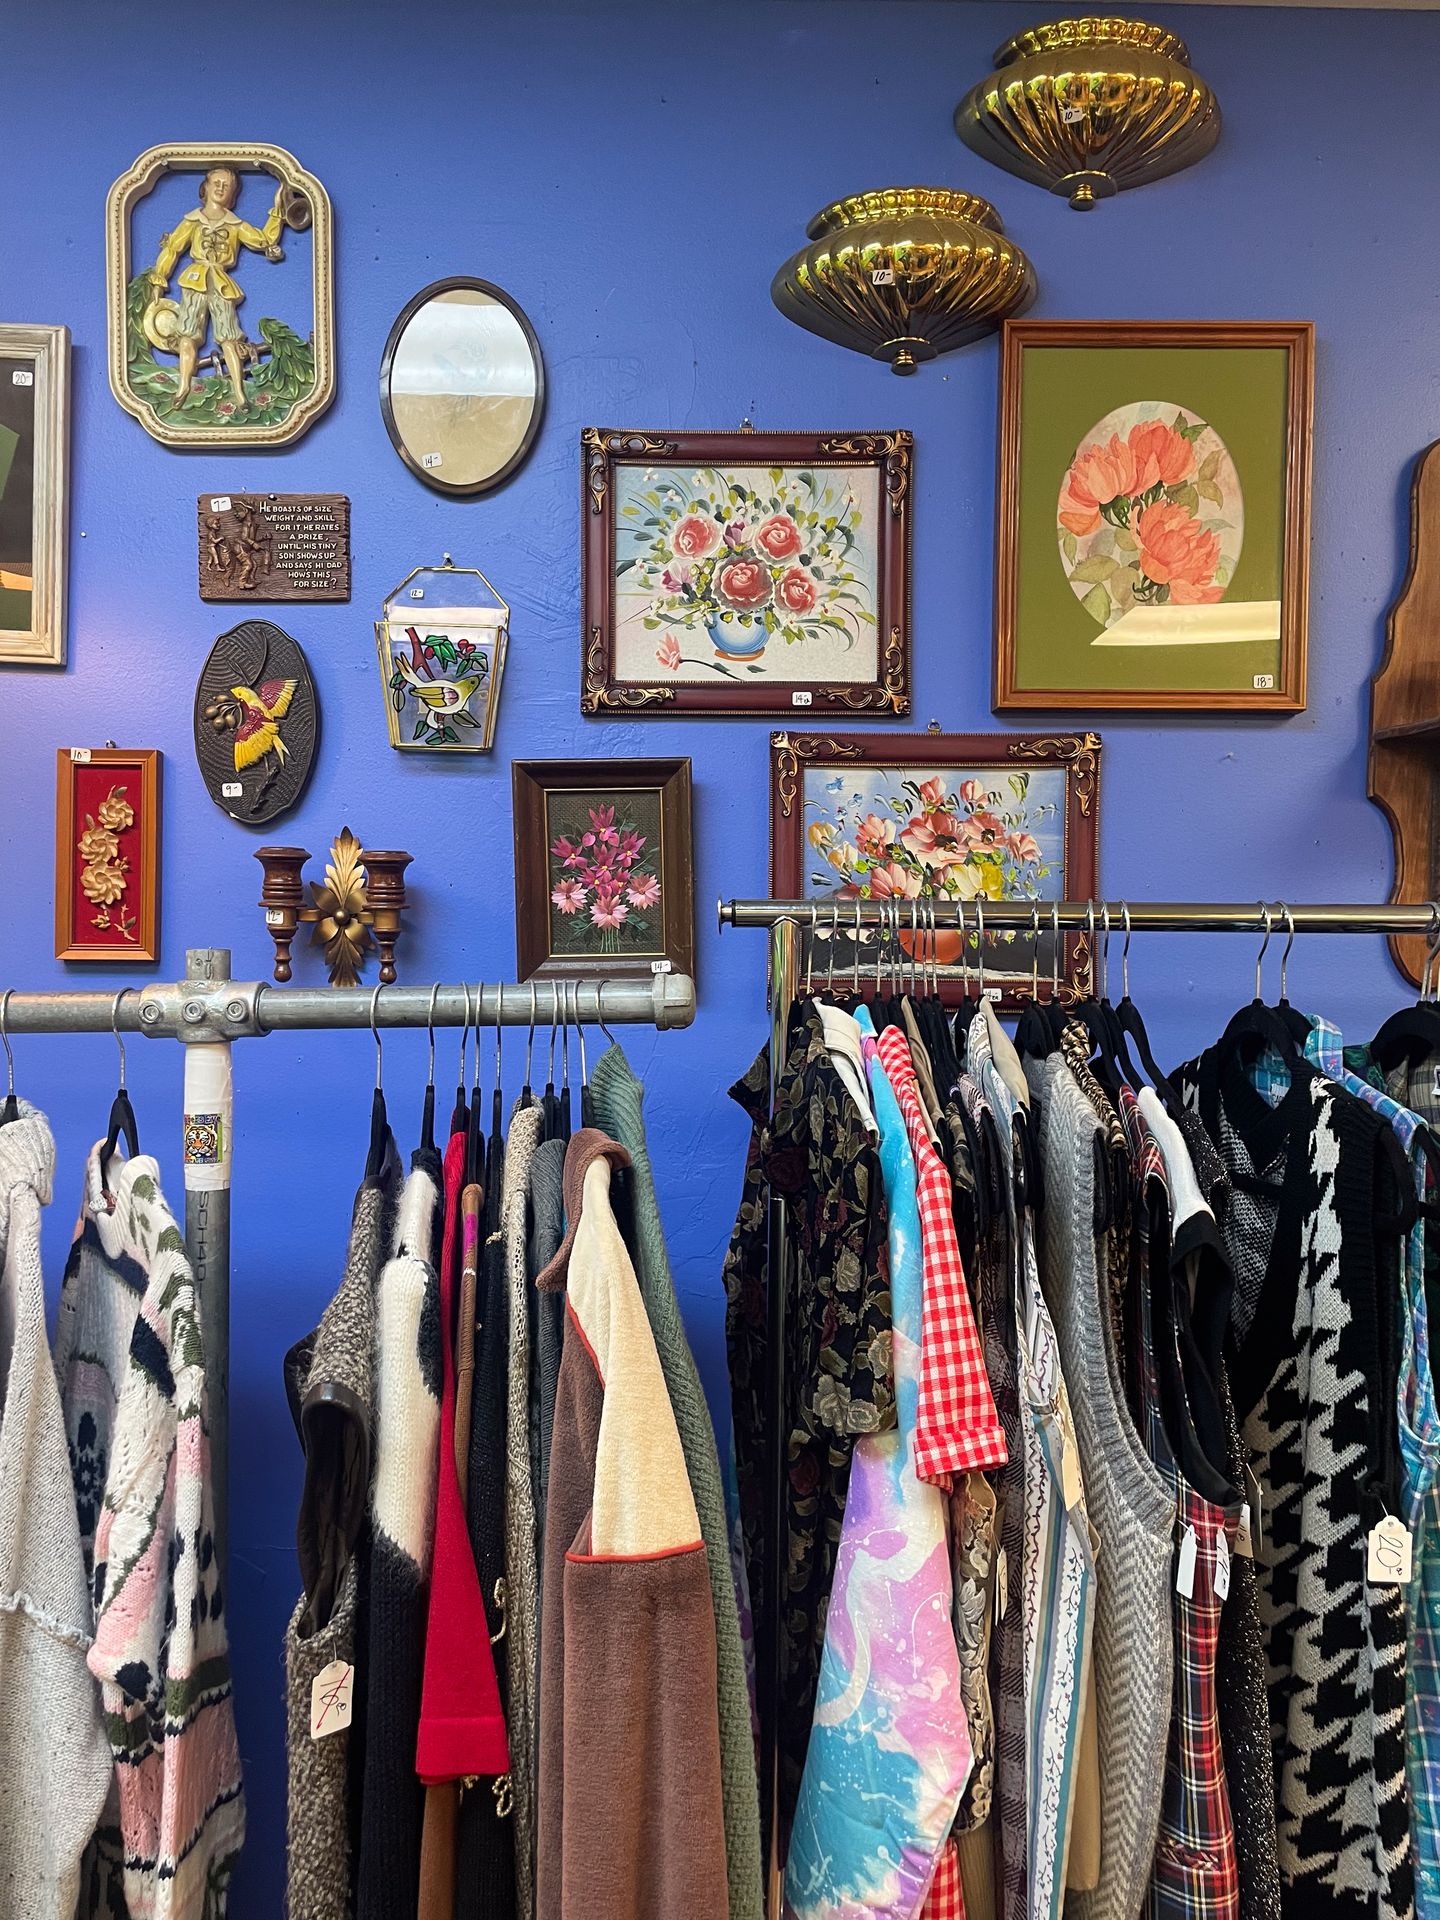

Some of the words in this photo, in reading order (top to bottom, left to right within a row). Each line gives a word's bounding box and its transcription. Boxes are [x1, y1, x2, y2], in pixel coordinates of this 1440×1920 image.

[264, 514, 295, 522] WEIGHT
[296, 514, 313, 522] AND
[313, 514, 335, 522] SKILL
[275, 523, 291, 531] FOR
[293, 523, 301, 531] IT
[303, 523, 313, 531] HE
[314, 523, 340, 531] RATES
[293, 580, 310, 588] FOR
